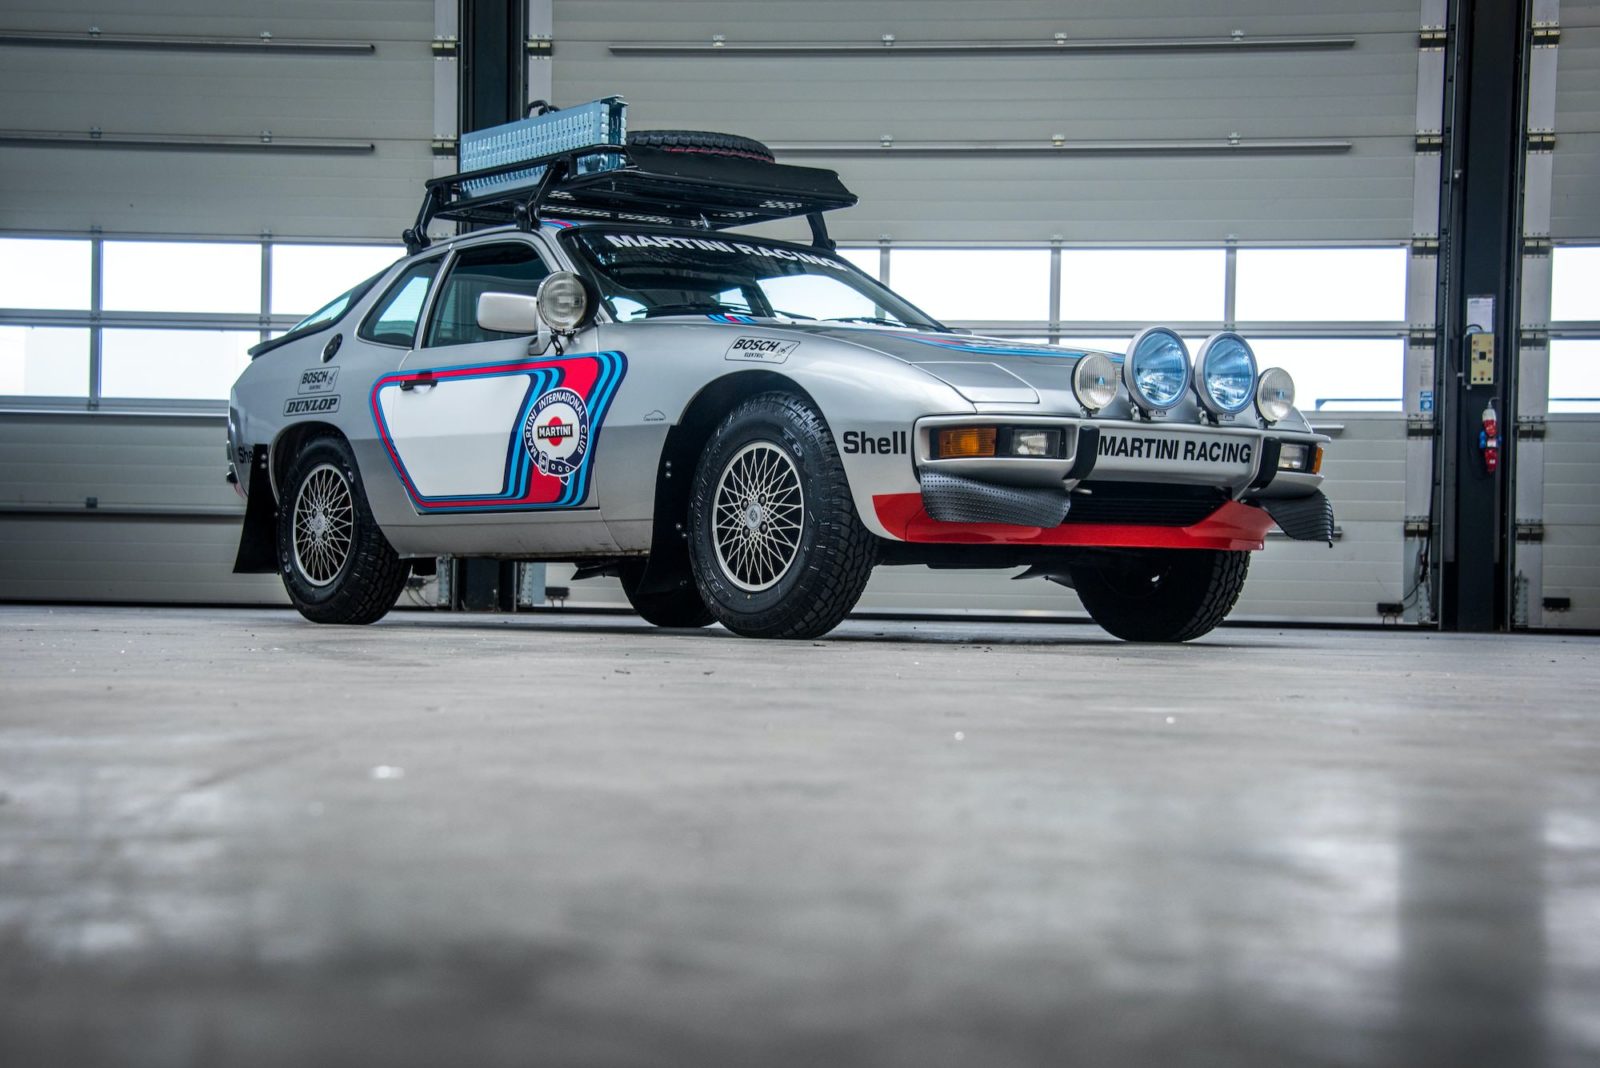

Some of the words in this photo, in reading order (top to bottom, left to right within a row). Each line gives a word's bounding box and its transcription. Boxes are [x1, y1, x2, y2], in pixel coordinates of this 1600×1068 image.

[604, 235, 736, 253] MARTINI
[733, 243, 848, 272] RACING
[733, 339, 781, 352] BOSCH
[302, 371, 329, 384] BOSCH
[286, 398, 338, 413] DUNLOP
[525, 409, 538, 459] MARTINI
[538, 391, 585, 420] INTERNATIONAL
[577, 424, 587, 455] CLUB
[539, 425, 571, 437] MARTINI
[843, 431, 906, 454] Shell
[1098, 435, 1179, 460] MARTINI
[1183, 440, 1252, 464] RACING
